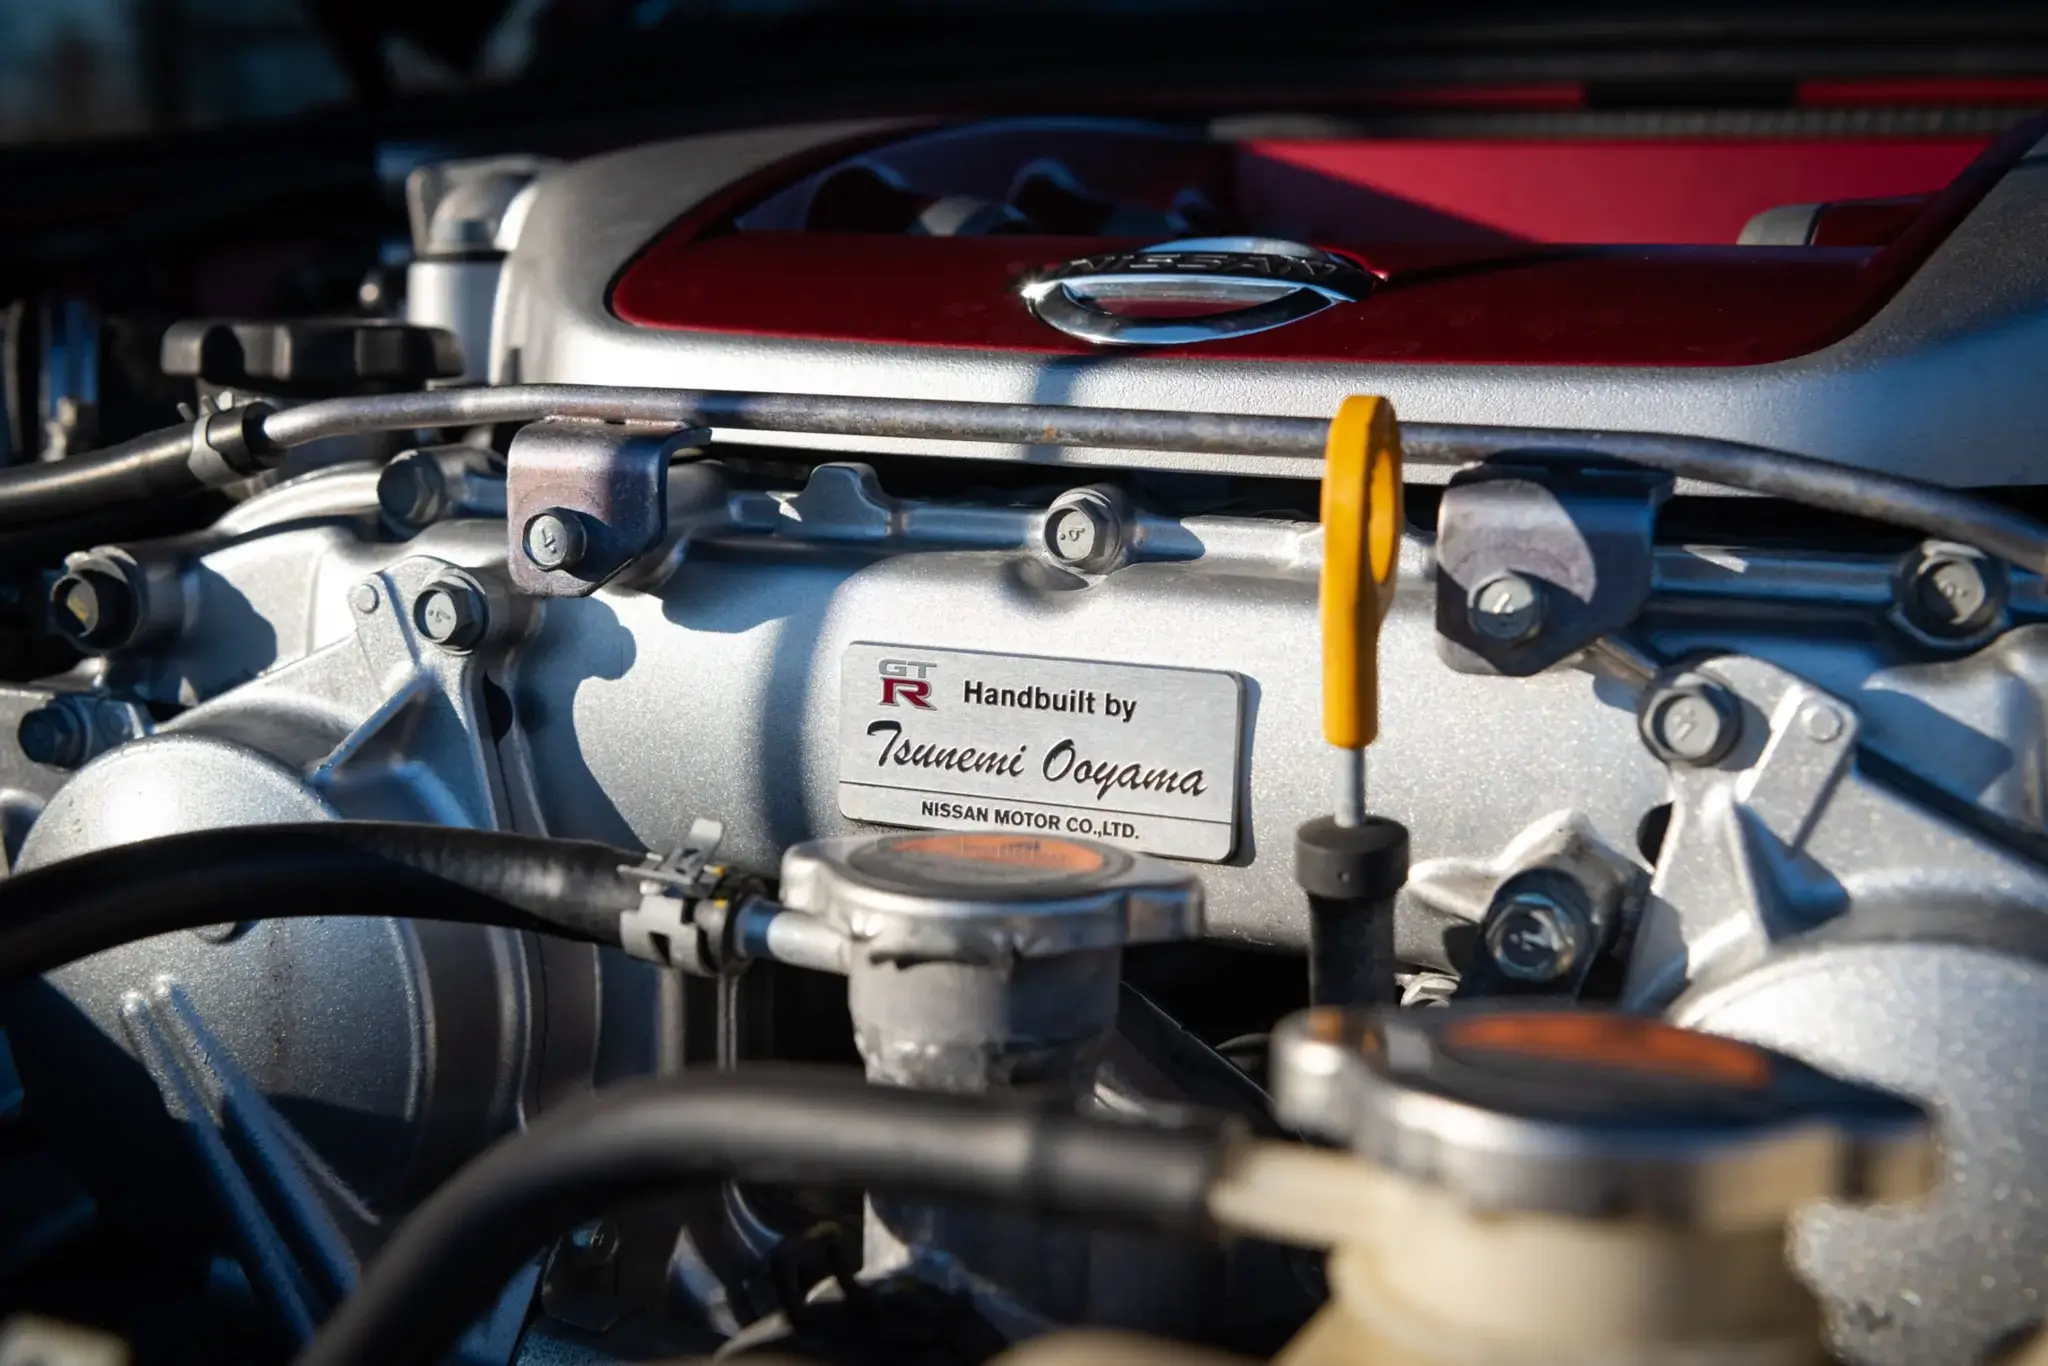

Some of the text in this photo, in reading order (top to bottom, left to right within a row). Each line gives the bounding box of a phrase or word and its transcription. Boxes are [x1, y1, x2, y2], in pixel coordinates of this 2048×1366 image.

[1060, 253, 1338, 276] NISSAN
[877, 659, 938, 678] GT
[878, 677, 938, 711] R
[963, 680, 1138, 722] Handbuilt by
[866, 719, 1208, 800] Tsunemi Ooyama
[921, 800, 1140, 839] NISSAN MOTOR CO.,LTD.
